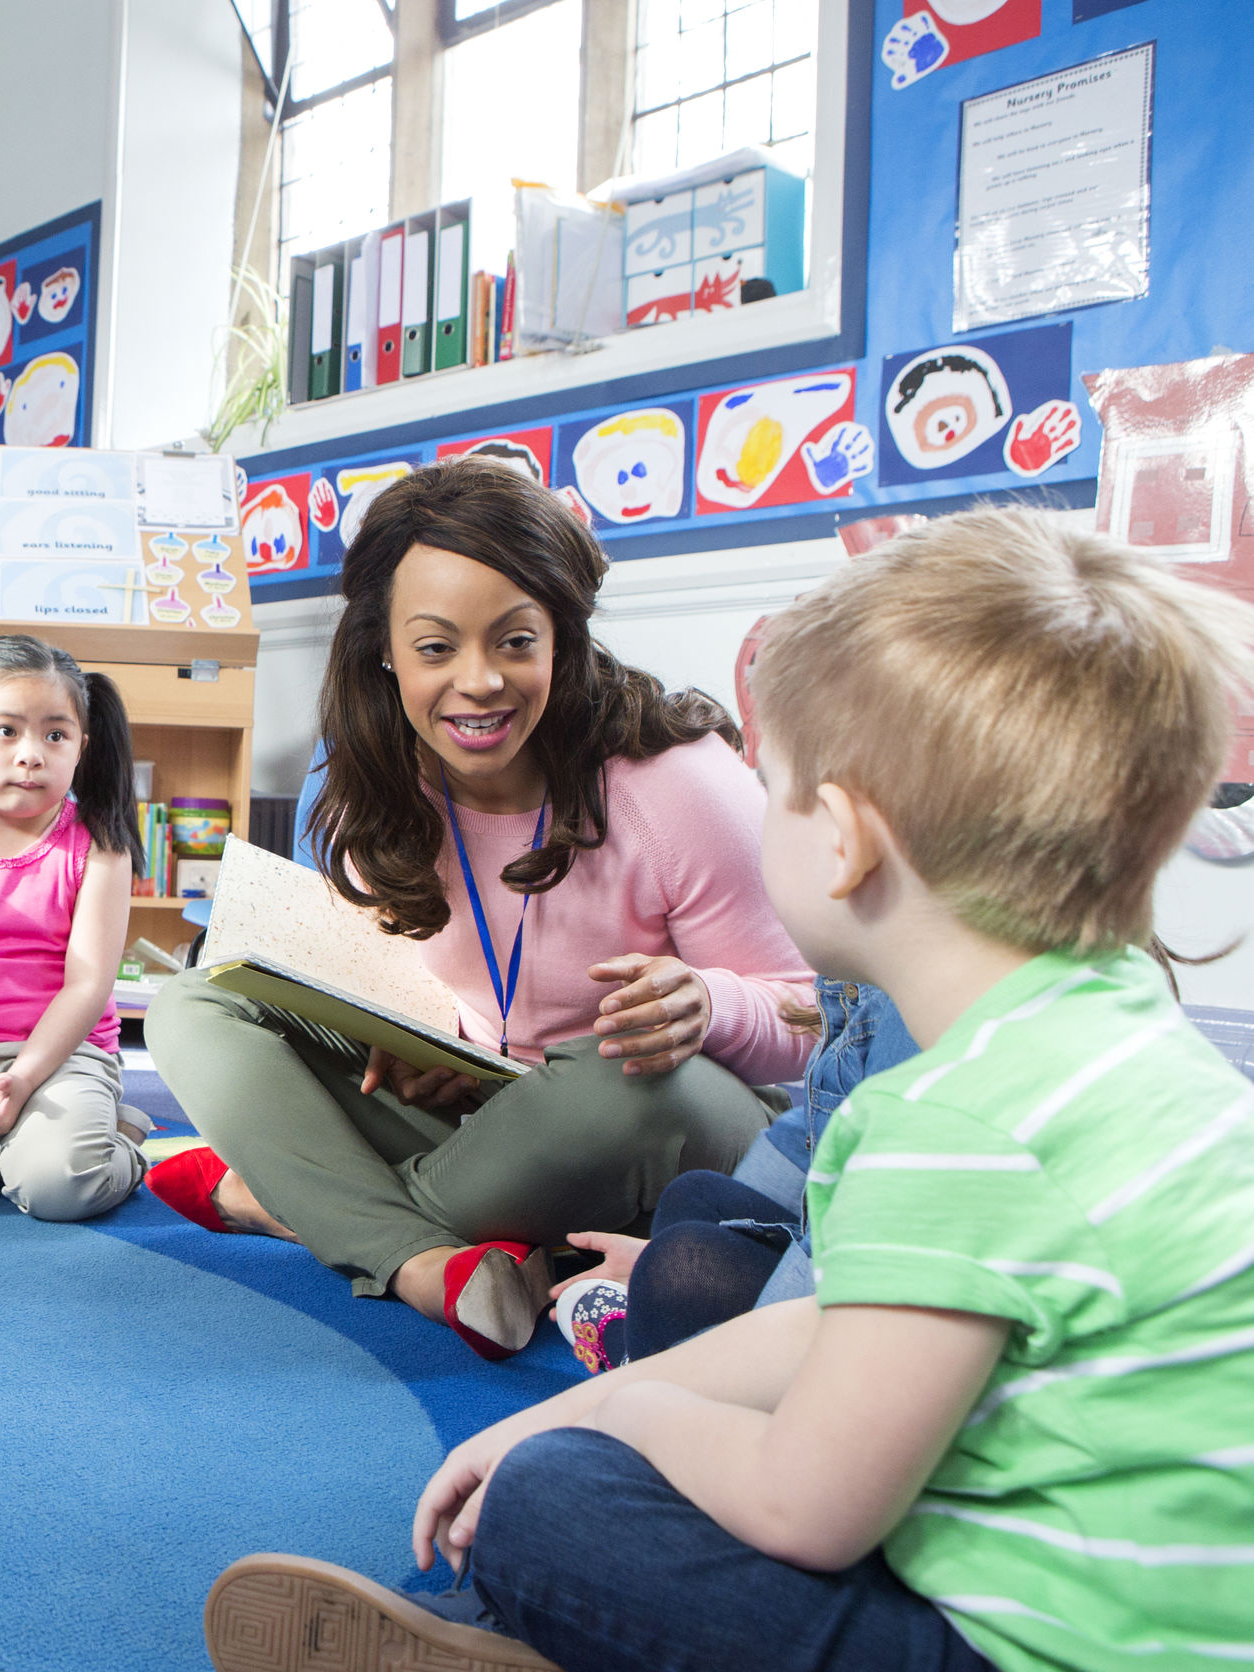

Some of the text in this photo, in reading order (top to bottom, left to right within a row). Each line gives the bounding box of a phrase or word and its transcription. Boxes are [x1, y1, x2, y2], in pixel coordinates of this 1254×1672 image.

[1006, 70, 1113, 109] Nursery Promises
[64, 489, 106, 498] sitting
[54, 542, 113, 551] listening
[34, 604, 108, 615] lips closed
